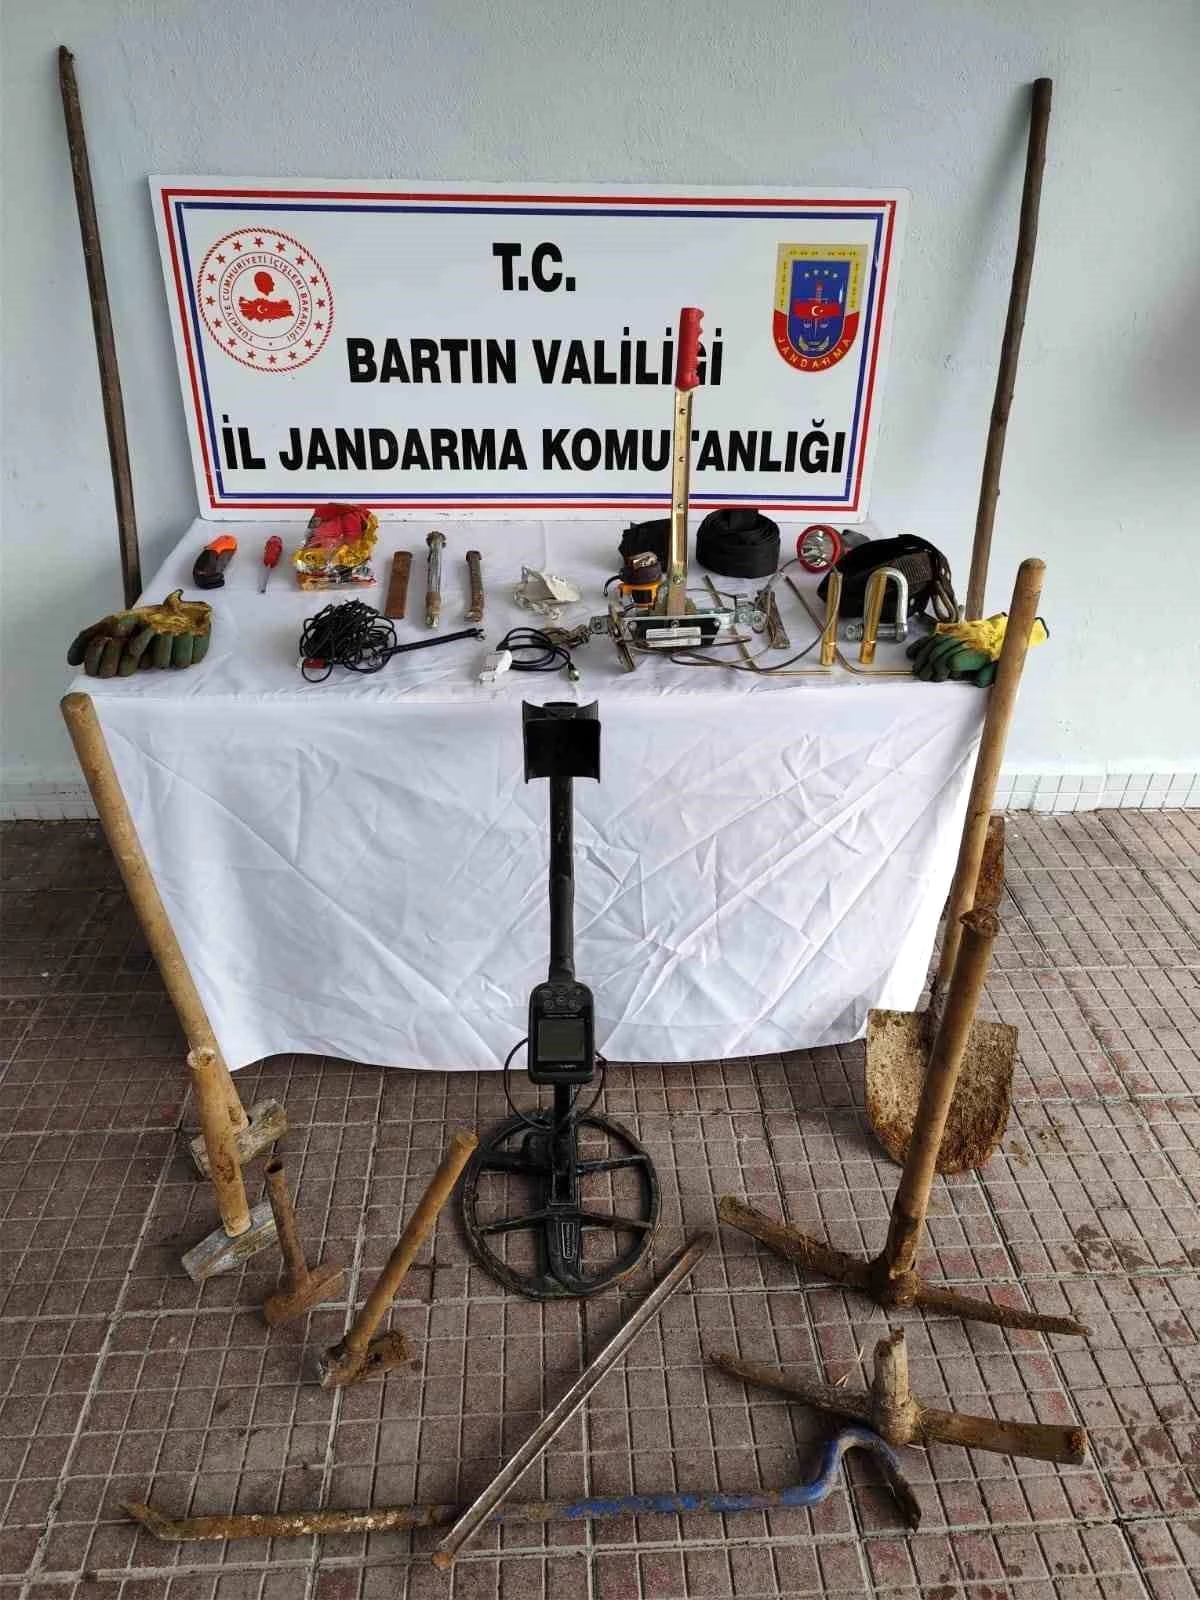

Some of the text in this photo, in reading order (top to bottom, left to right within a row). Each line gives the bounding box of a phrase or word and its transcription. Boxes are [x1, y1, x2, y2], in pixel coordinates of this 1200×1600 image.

[492, 242, 576, 293] T.C.
[346, 337, 517, 384] BARTIN
[778, 337, 851, 368] JANDARMA
[222, 414, 267, 470] İL
[278, 427, 528, 471] JANDARMA
